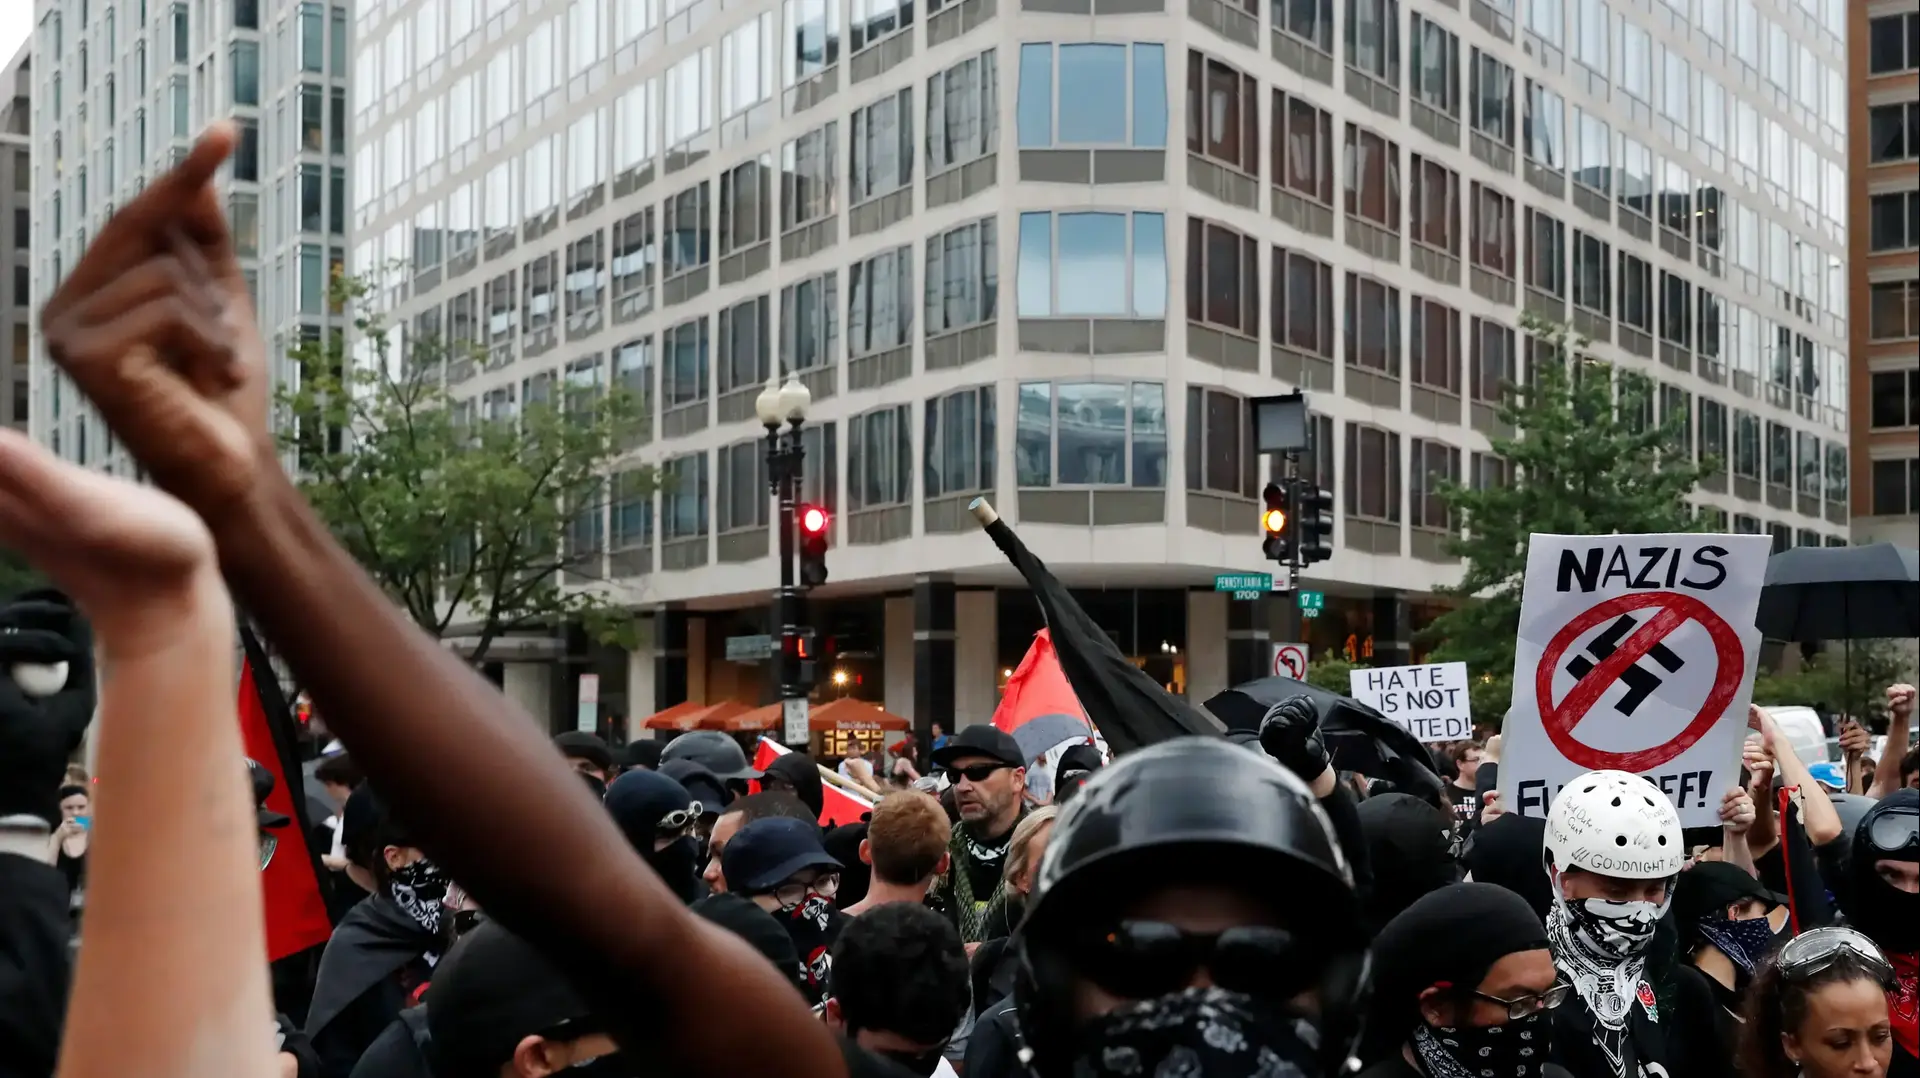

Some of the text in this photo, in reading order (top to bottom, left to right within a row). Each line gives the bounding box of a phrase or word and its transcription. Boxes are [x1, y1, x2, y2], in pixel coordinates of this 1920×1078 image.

[1556, 544, 1729, 593] NAZIS
[1217, 576, 1261, 589] PENNSYLVANIA
[1235, 590, 1260, 600] 1700
[1301, 593, 1311, 606] 17
[1303, 608, 1319, 617] 700
[1368, 667, 1445, 691] HATE
[1380, 688, 1461, 713] IS NOT
[1641, 770, 1713, 809] FF!
[1590, 852, 1665, 873] GOODNIGHT
